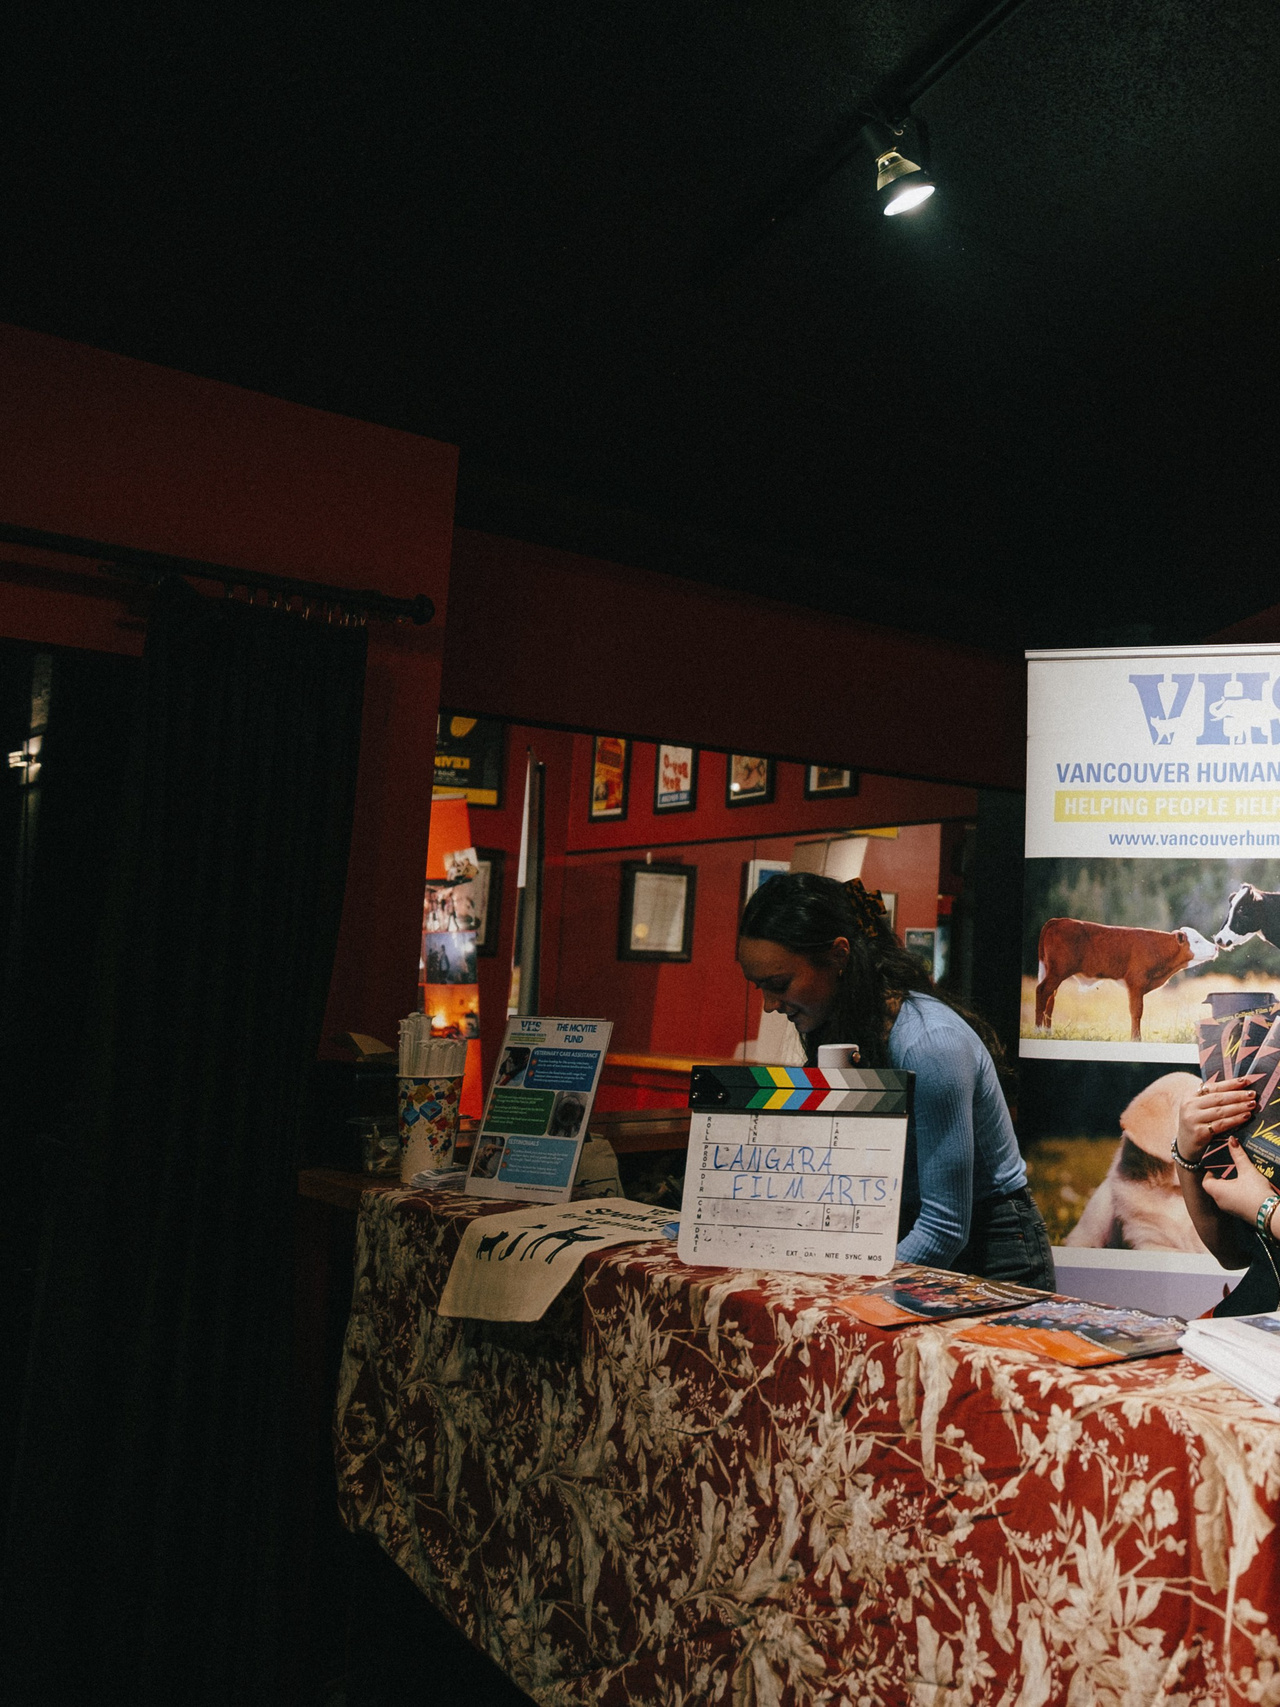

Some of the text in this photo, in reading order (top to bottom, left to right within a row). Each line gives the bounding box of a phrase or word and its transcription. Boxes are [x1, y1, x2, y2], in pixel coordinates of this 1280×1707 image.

[1056, 762, 1189, 784] VANCOUVER
[1064, 797, 1148, 816] HELPING
[1155, 797, 1228, 816] PEOPLE
[1235, 796, 1280, 815] HELP
[521, 1021, 541, 1032] VHS
[557, 1023, 568, 1031] THE
[564, 1035, 583, 1043] FUND
[713, 1145, 832, 1173] LANGARA
[732, 1174, 805, 1200] FILM
[825, 1252, 840, 1260] NITE
[845, 1253, 863, 1261] SYNC
